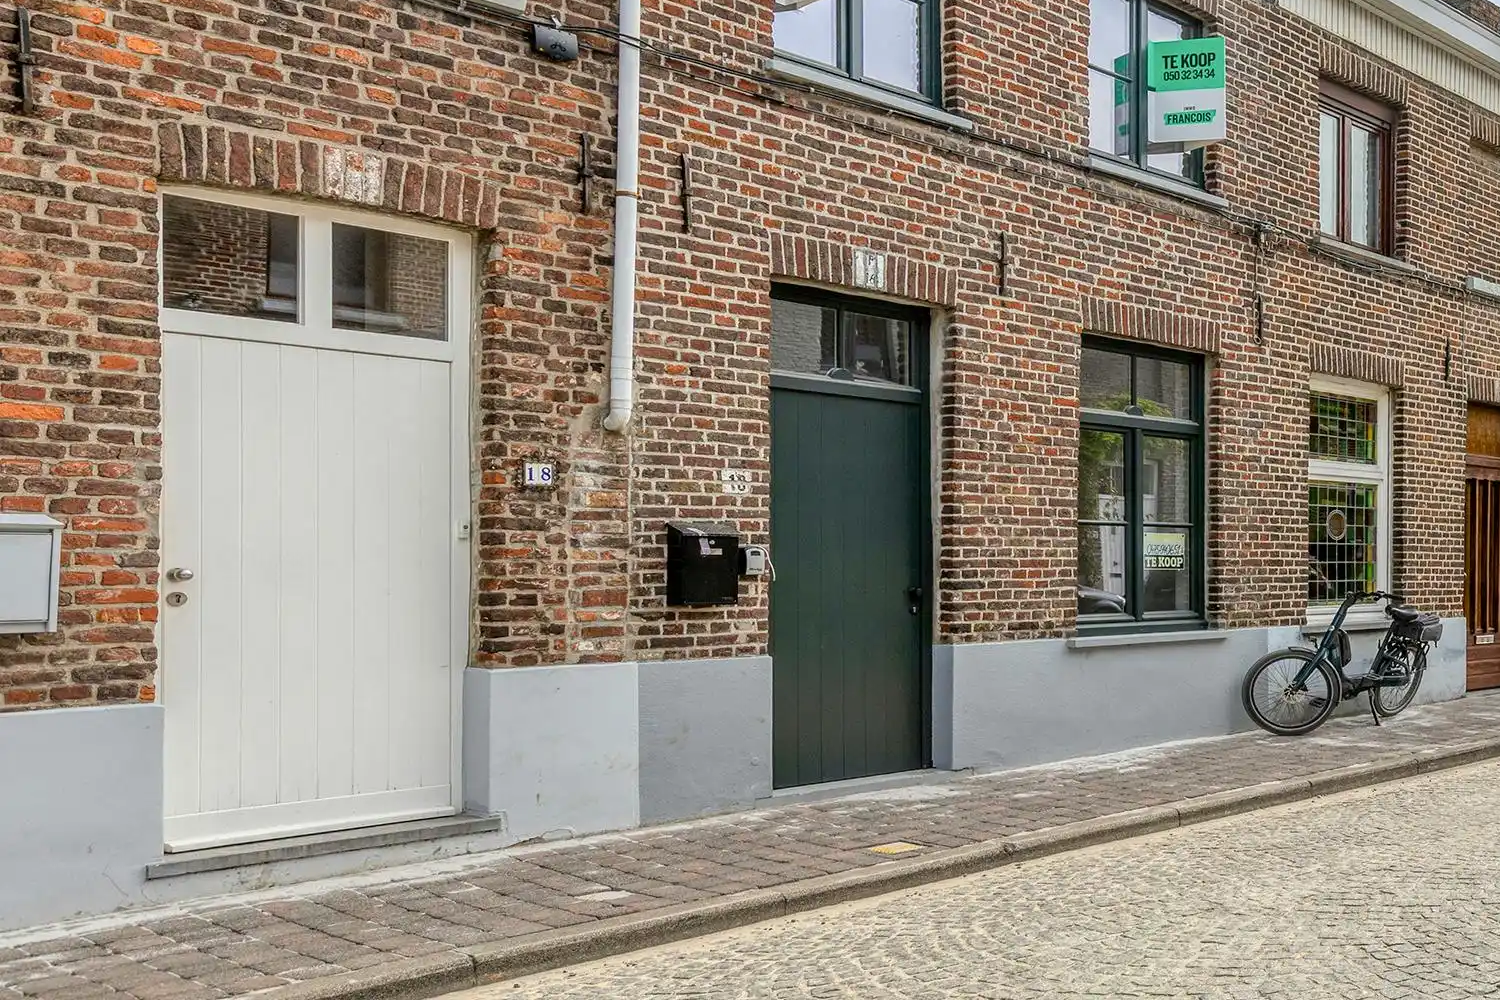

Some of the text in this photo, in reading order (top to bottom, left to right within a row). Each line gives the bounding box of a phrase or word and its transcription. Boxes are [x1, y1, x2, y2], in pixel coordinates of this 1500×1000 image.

[1162, 52, 1216, 69] TE KOOP
[1163, 68, 1215, 82] 050 32 34 34
[1167, 112, 1212, 125] FRANCOIS
[527, 466, 552, 482] 18
[1145, 556, 1184, 568] TE KOOP
